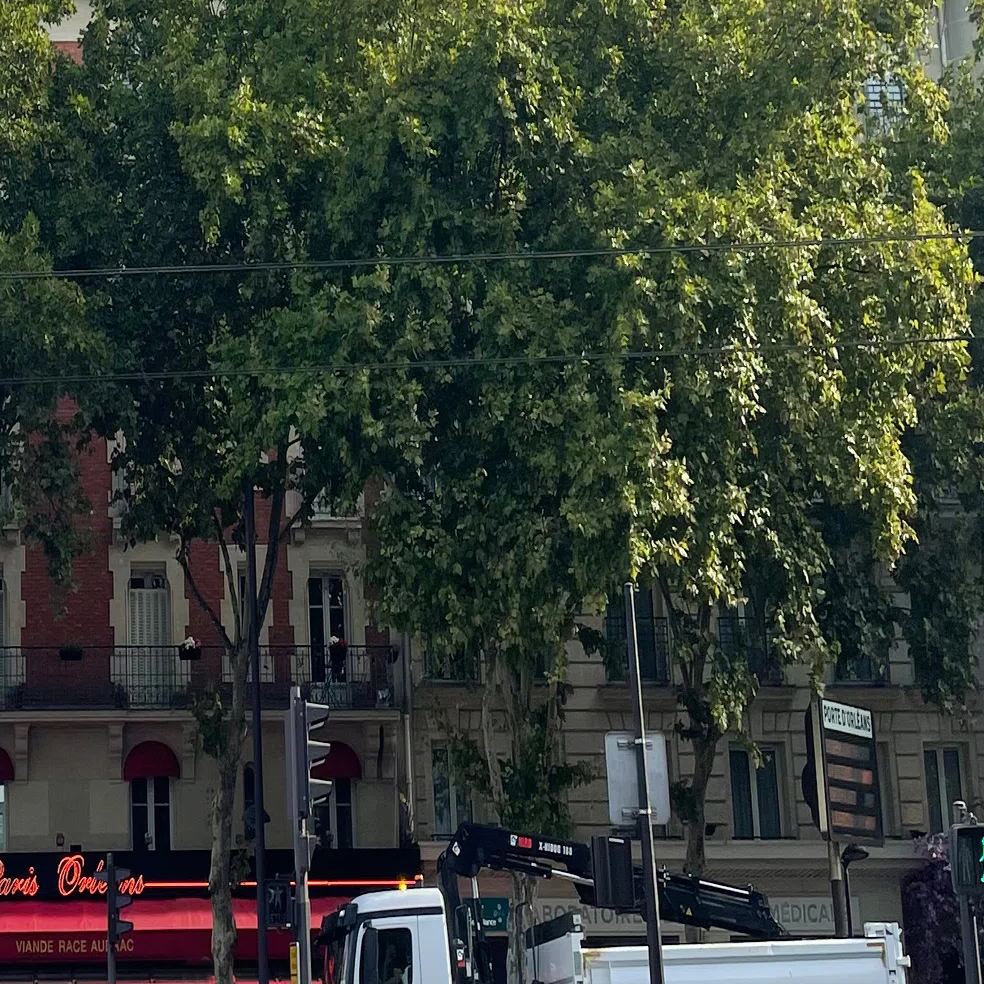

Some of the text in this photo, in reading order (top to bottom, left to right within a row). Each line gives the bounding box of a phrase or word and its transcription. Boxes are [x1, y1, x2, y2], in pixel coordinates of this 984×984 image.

[824, 705, 841, 725] PORTE
[16, 940, 54, 953] VIANDE
[58, 939, 87, 953] RACE
